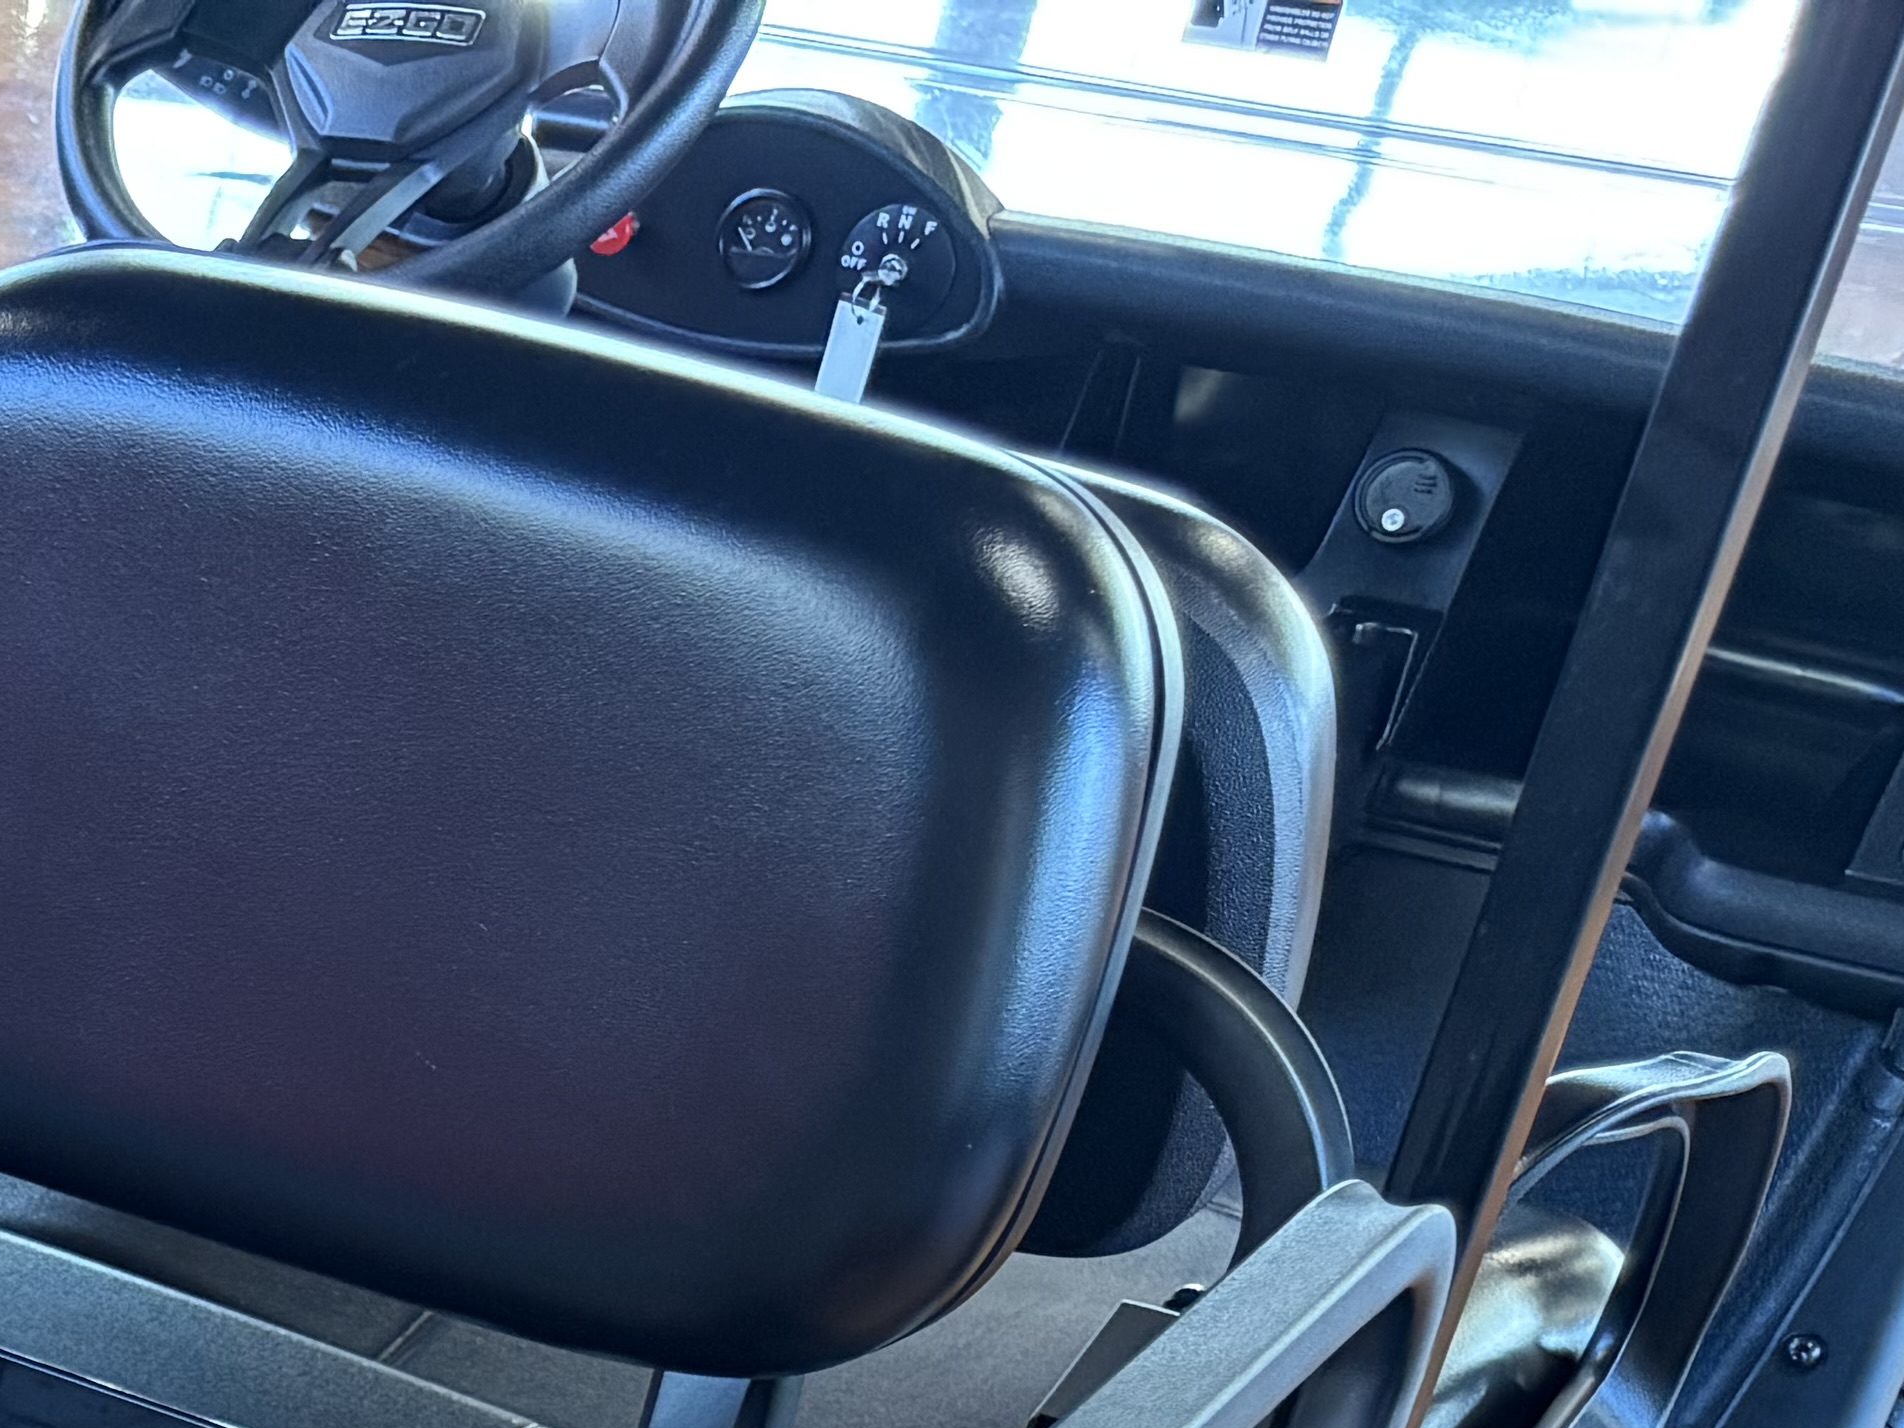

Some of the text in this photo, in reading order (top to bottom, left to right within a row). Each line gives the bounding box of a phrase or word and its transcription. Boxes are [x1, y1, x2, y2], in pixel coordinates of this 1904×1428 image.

[876, 212, 890, 228] R
[898, 214, 913, 230] N
[924, 221, 938, 235] F
[841, 255, 867, 271] OFF
